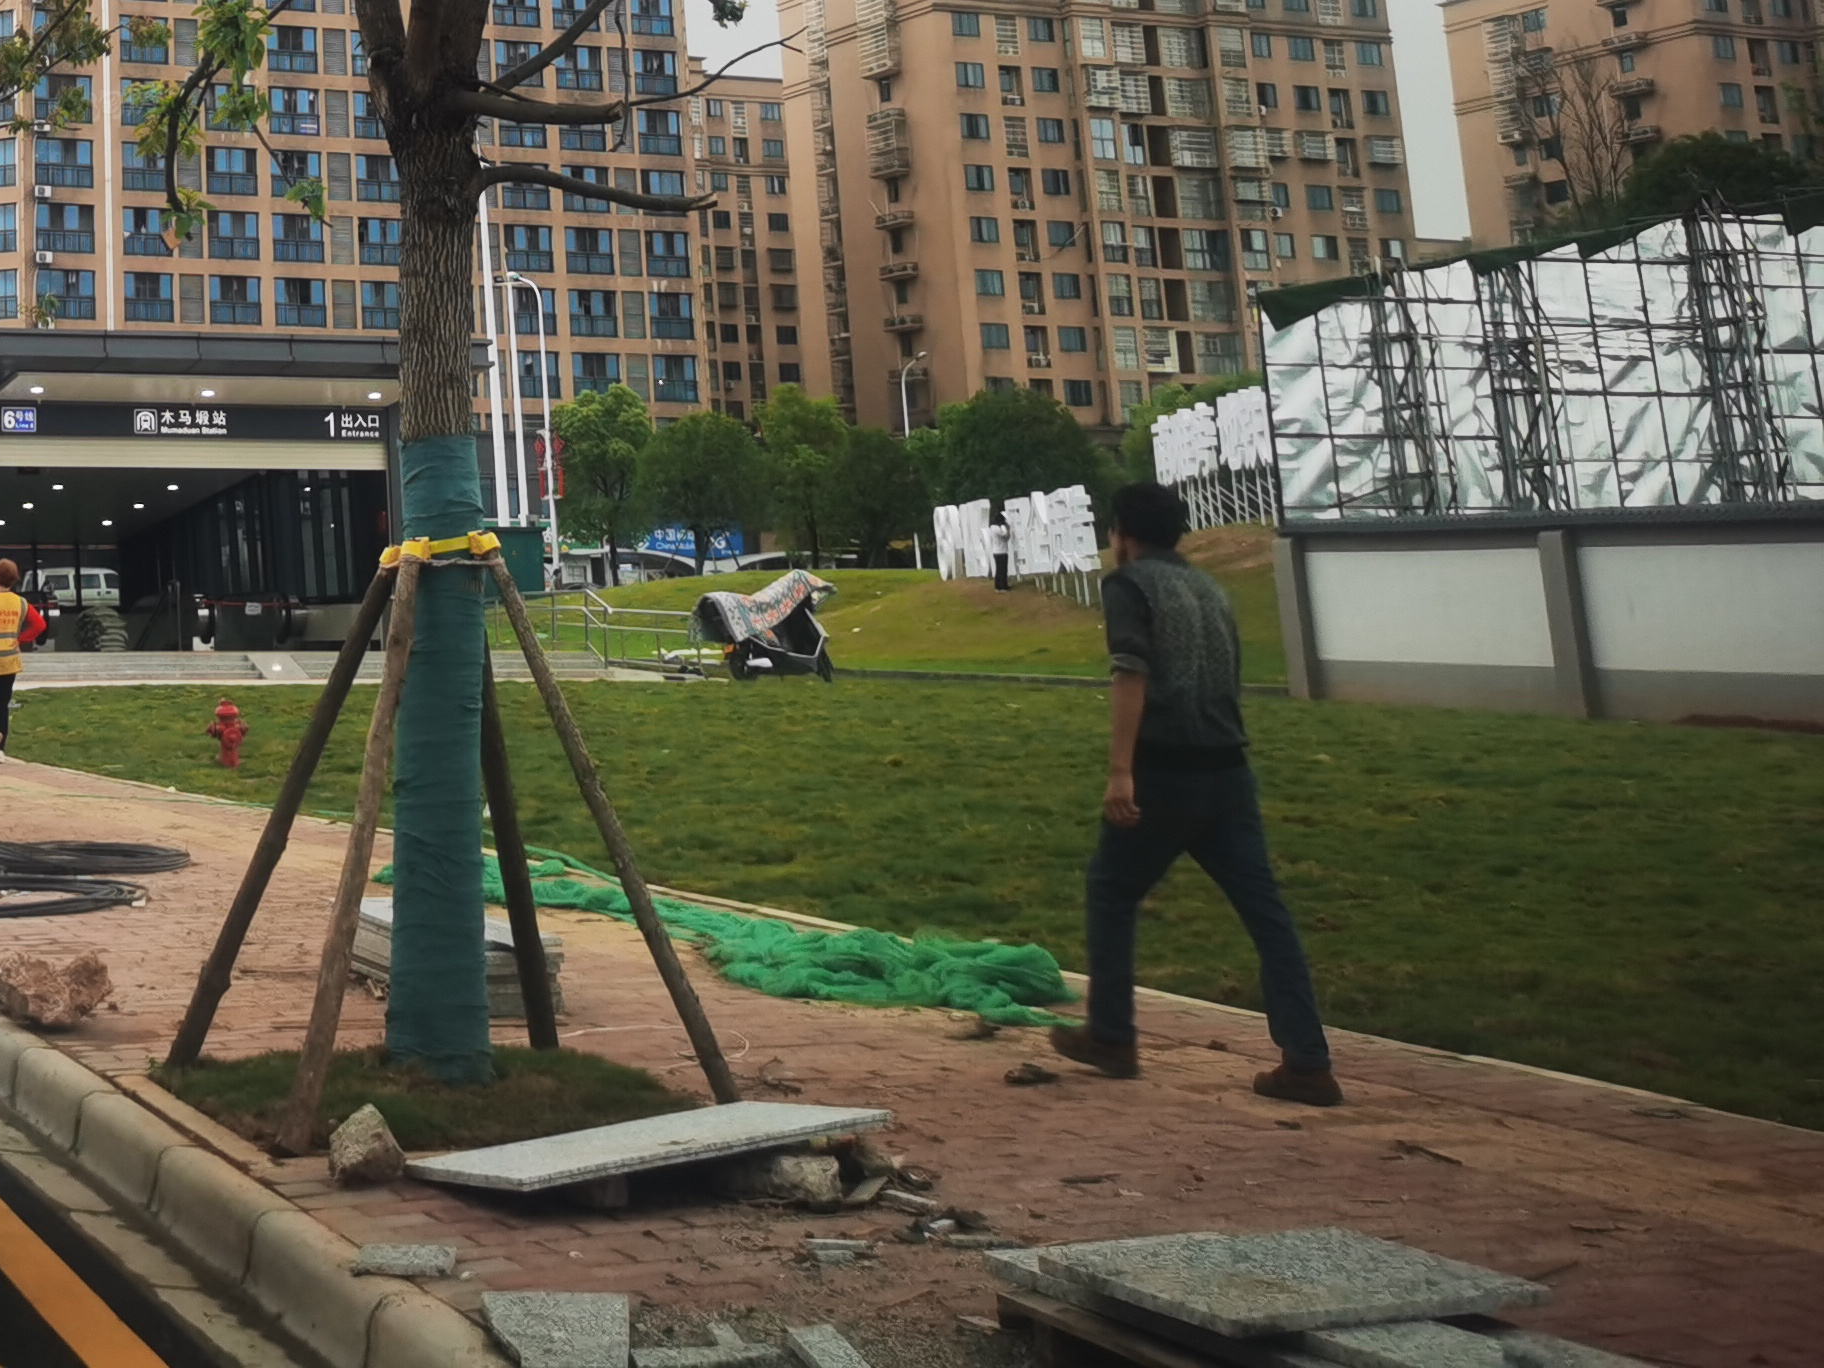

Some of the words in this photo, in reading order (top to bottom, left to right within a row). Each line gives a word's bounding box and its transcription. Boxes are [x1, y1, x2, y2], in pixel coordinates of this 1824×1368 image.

[324, 412, 335, 438] 1
[341, 413, 380, 428] 出入口
[341, 429, 380, 438] Entrance
